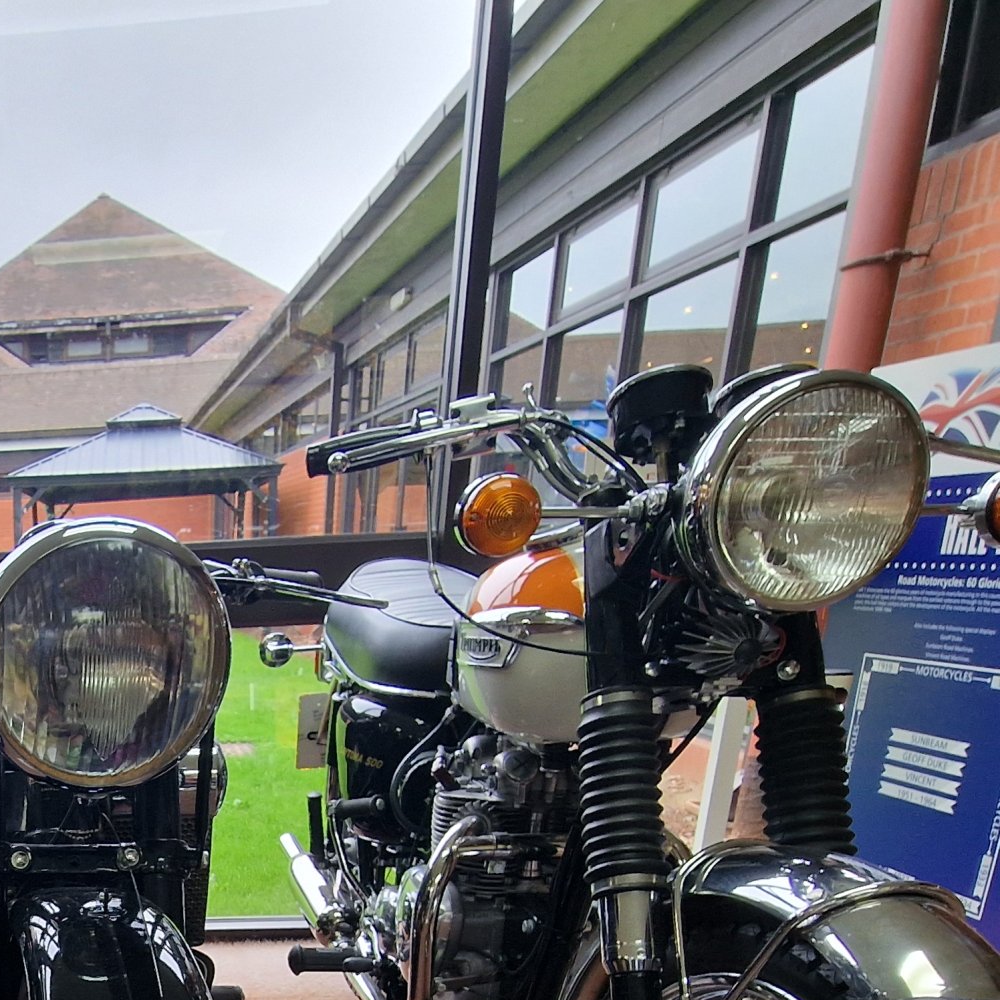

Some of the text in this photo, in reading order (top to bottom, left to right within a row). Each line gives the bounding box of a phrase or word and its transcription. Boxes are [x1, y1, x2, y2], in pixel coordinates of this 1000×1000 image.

[940, 514, 988, 555] HALL
[898, 575, 915, 587] Road
[916, 575, 964, 590] Motorcycles:
[966, 577, 976, 588] 60
[914, 665, 974, 683] MOTORCYCLES
[911, 734, 948, 751] SUNBEAM
[364, 756, 384, 770] 500
[902, 752, 949, 771] GEOFF DUKE
[905, 771, 937, 788] VINCENT
